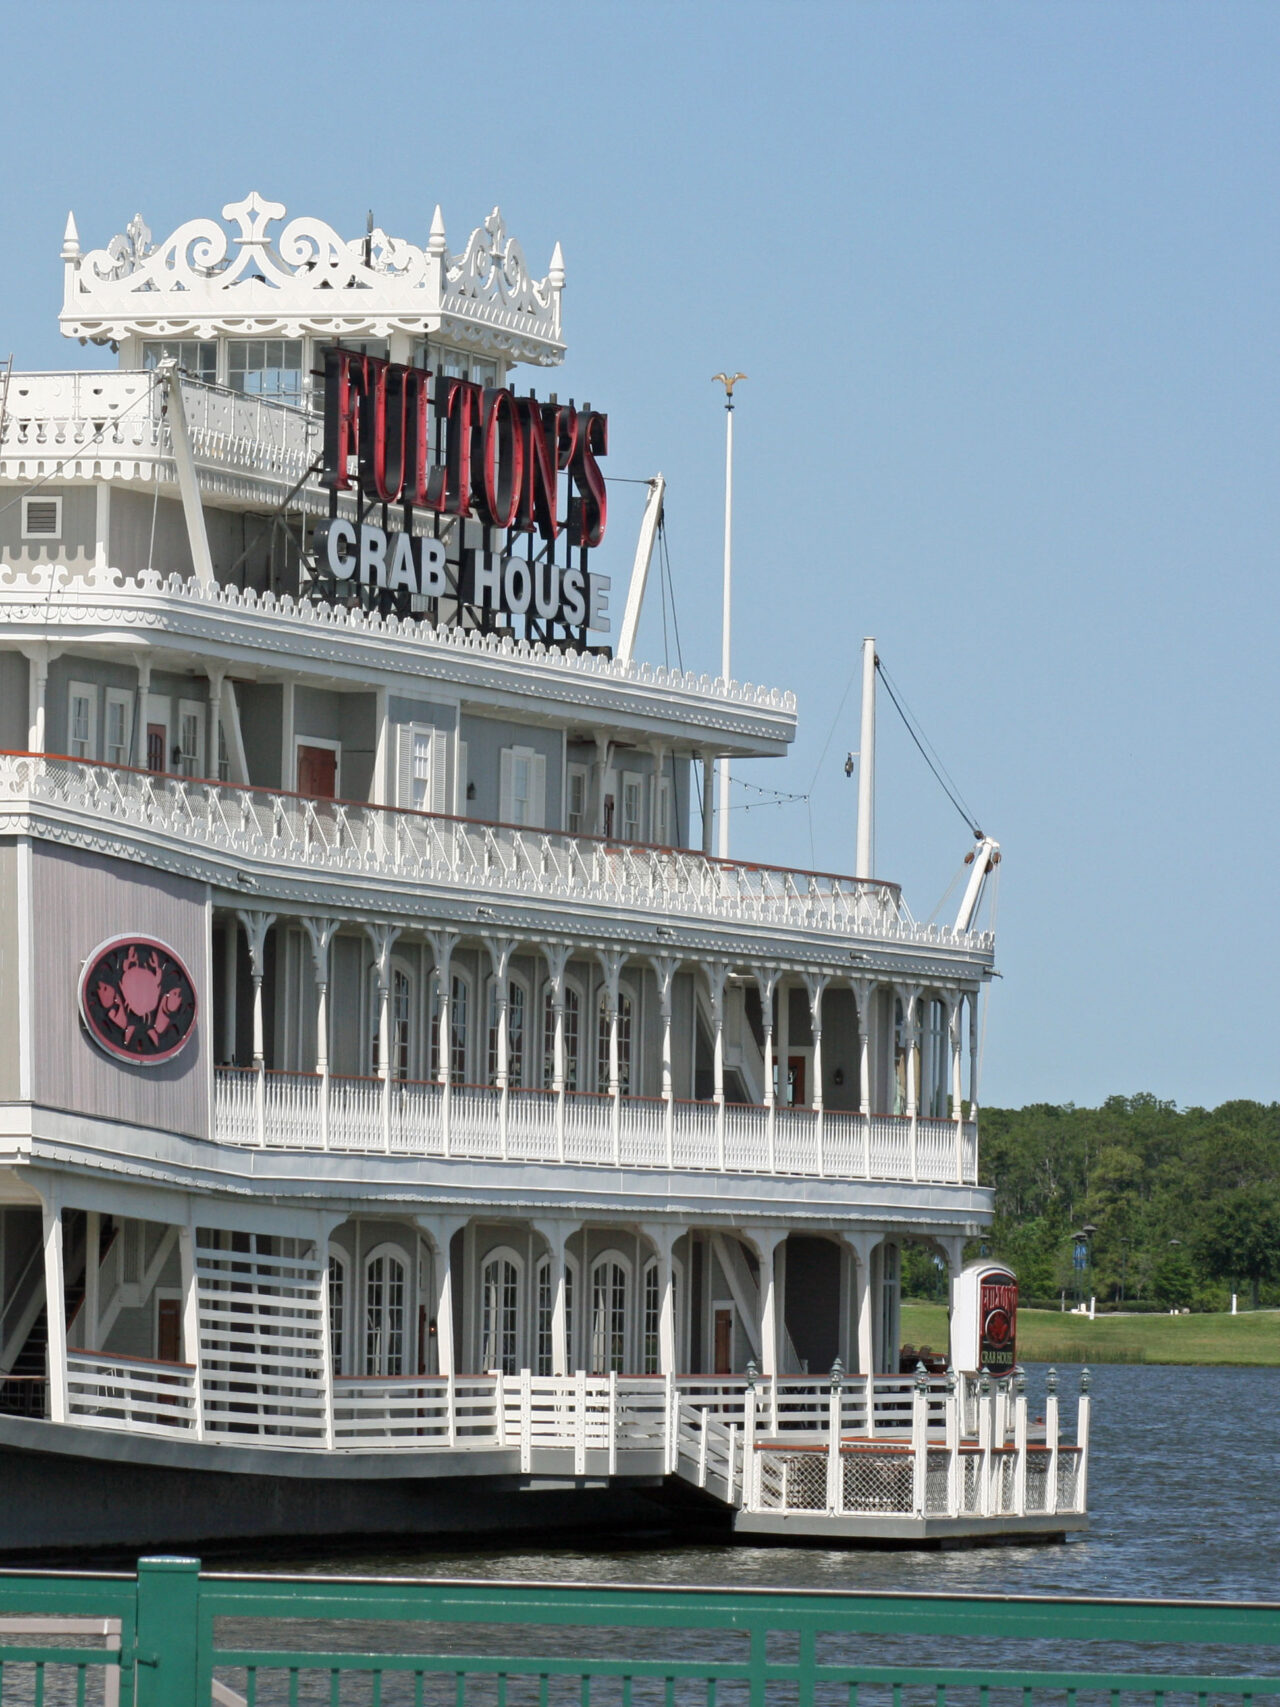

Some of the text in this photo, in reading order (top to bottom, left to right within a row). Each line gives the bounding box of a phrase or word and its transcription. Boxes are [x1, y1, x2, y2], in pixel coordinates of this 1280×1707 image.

[321, 347, 608, 548] FULTON'S
[322, 518, 612, 633] CRAB HOUSE
